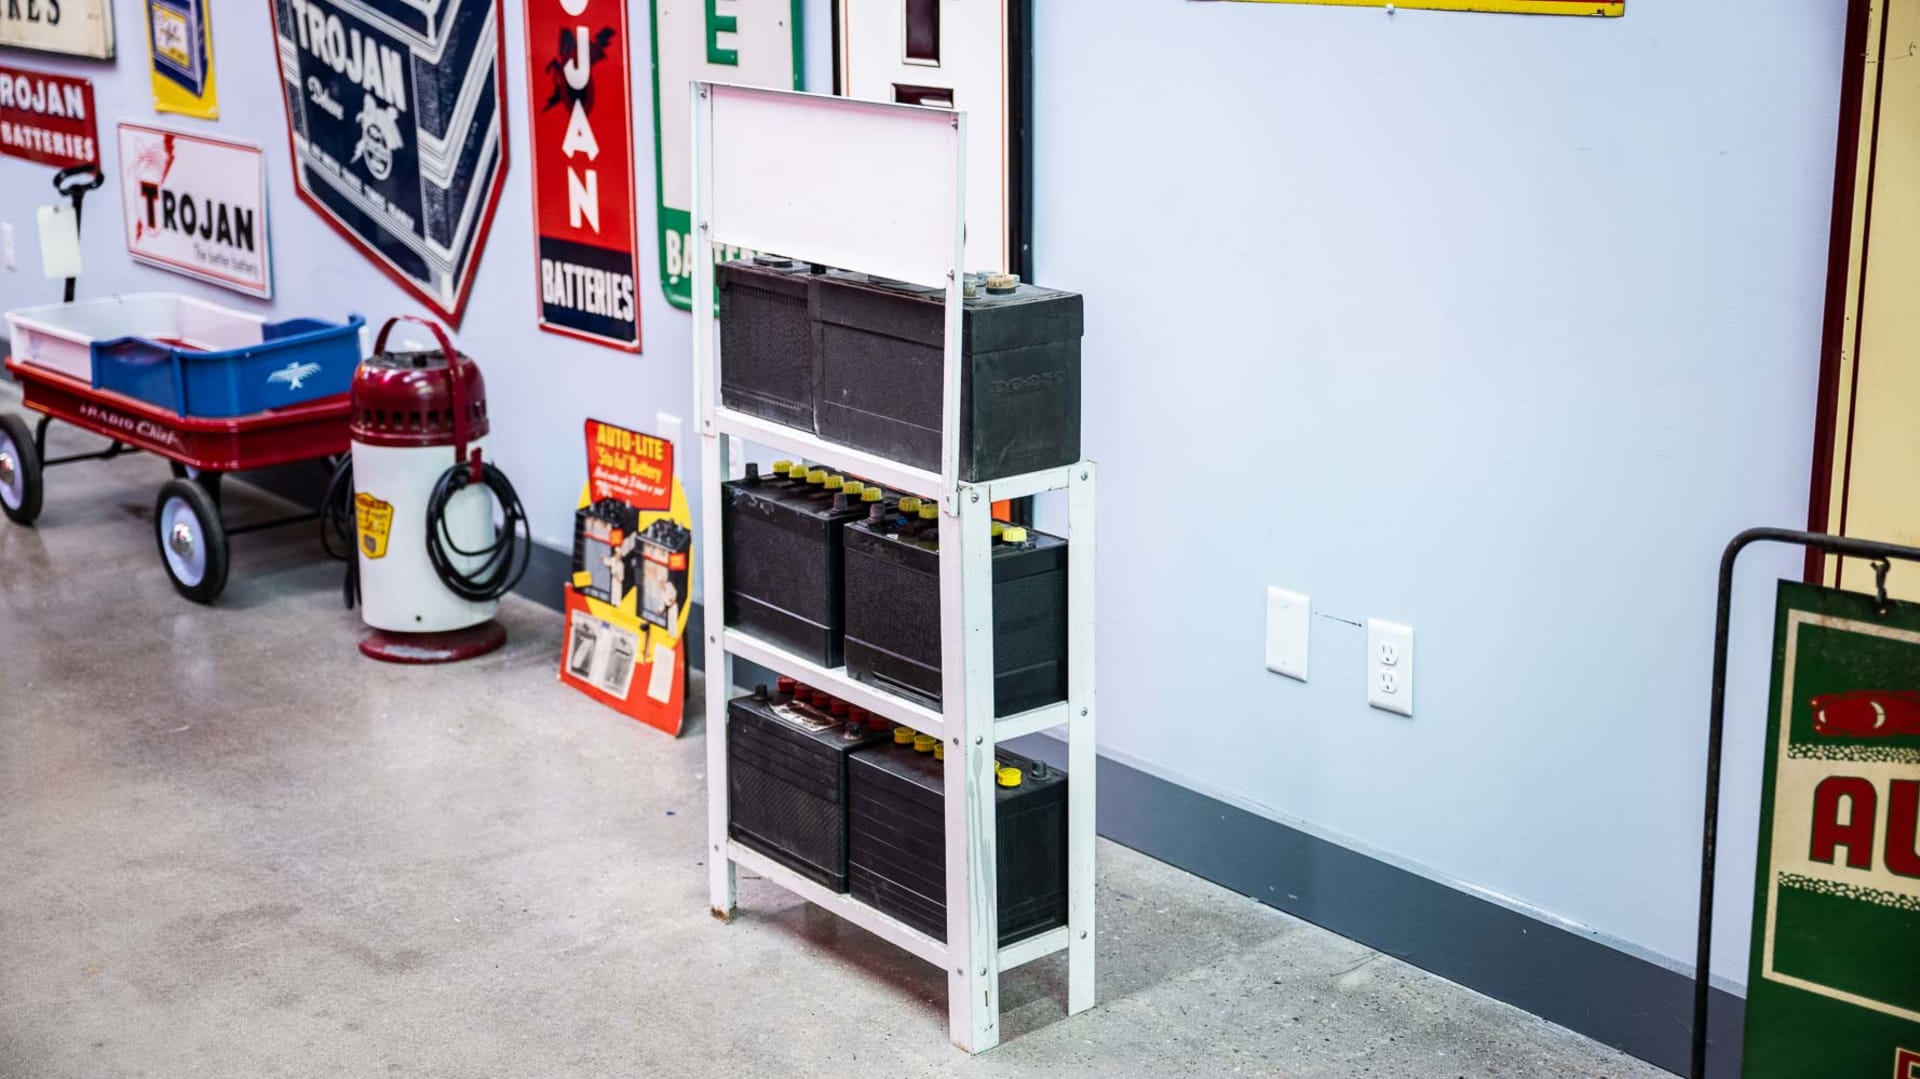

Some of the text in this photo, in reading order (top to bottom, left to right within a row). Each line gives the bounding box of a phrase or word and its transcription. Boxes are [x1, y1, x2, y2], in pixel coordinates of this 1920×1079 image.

[292, 2, 407, 112] TROJAN
[1, 121, 95, 163] BATTERIES
[140, 181, 255, 252] TROJAN
[541, 258, 635, 323] BATTERIES
[597, 423, 664, 462] AUTO-LITE
